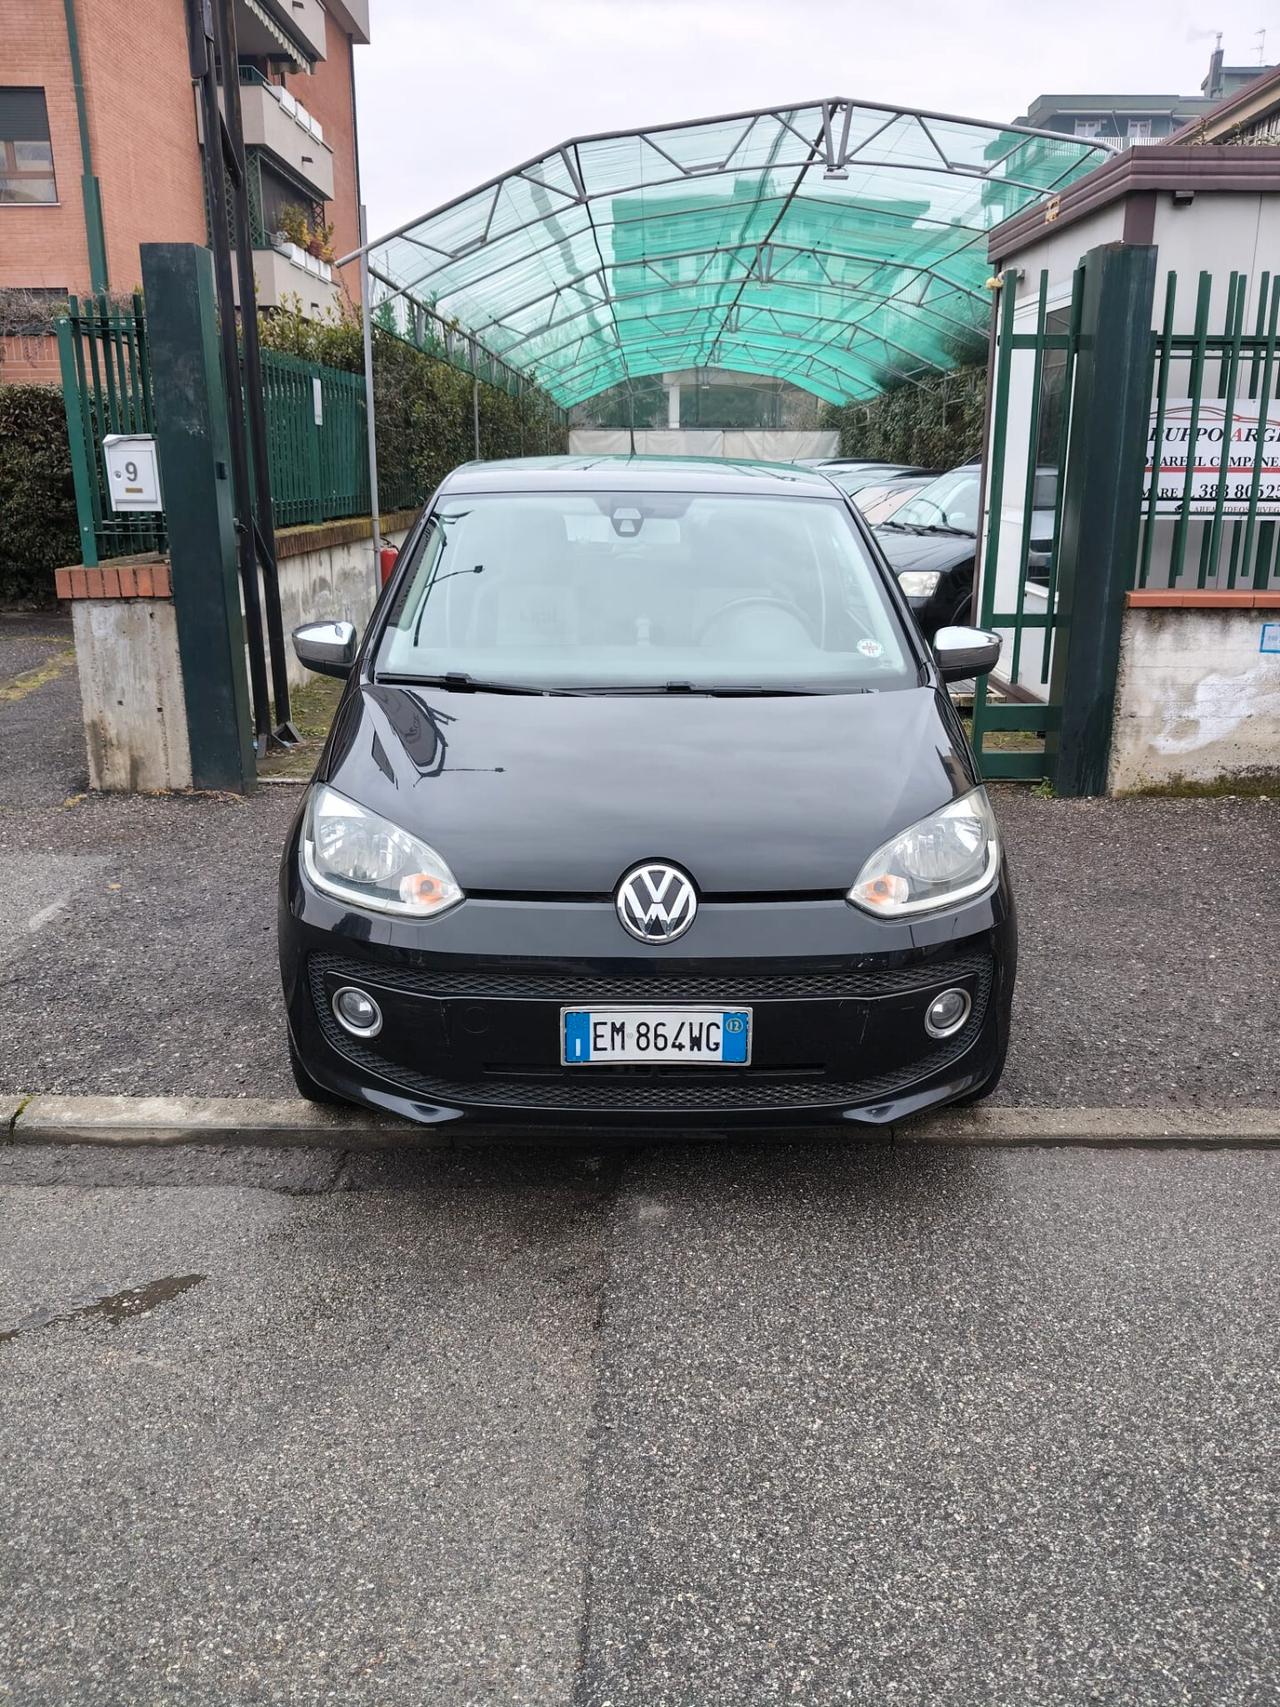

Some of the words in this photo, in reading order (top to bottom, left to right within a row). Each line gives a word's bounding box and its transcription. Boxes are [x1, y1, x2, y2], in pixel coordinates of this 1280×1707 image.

[125, 461, 138, 482] 9
[593, 1021, 626, 1051] EM
[635, 1021, 721, 1052] 864WG
